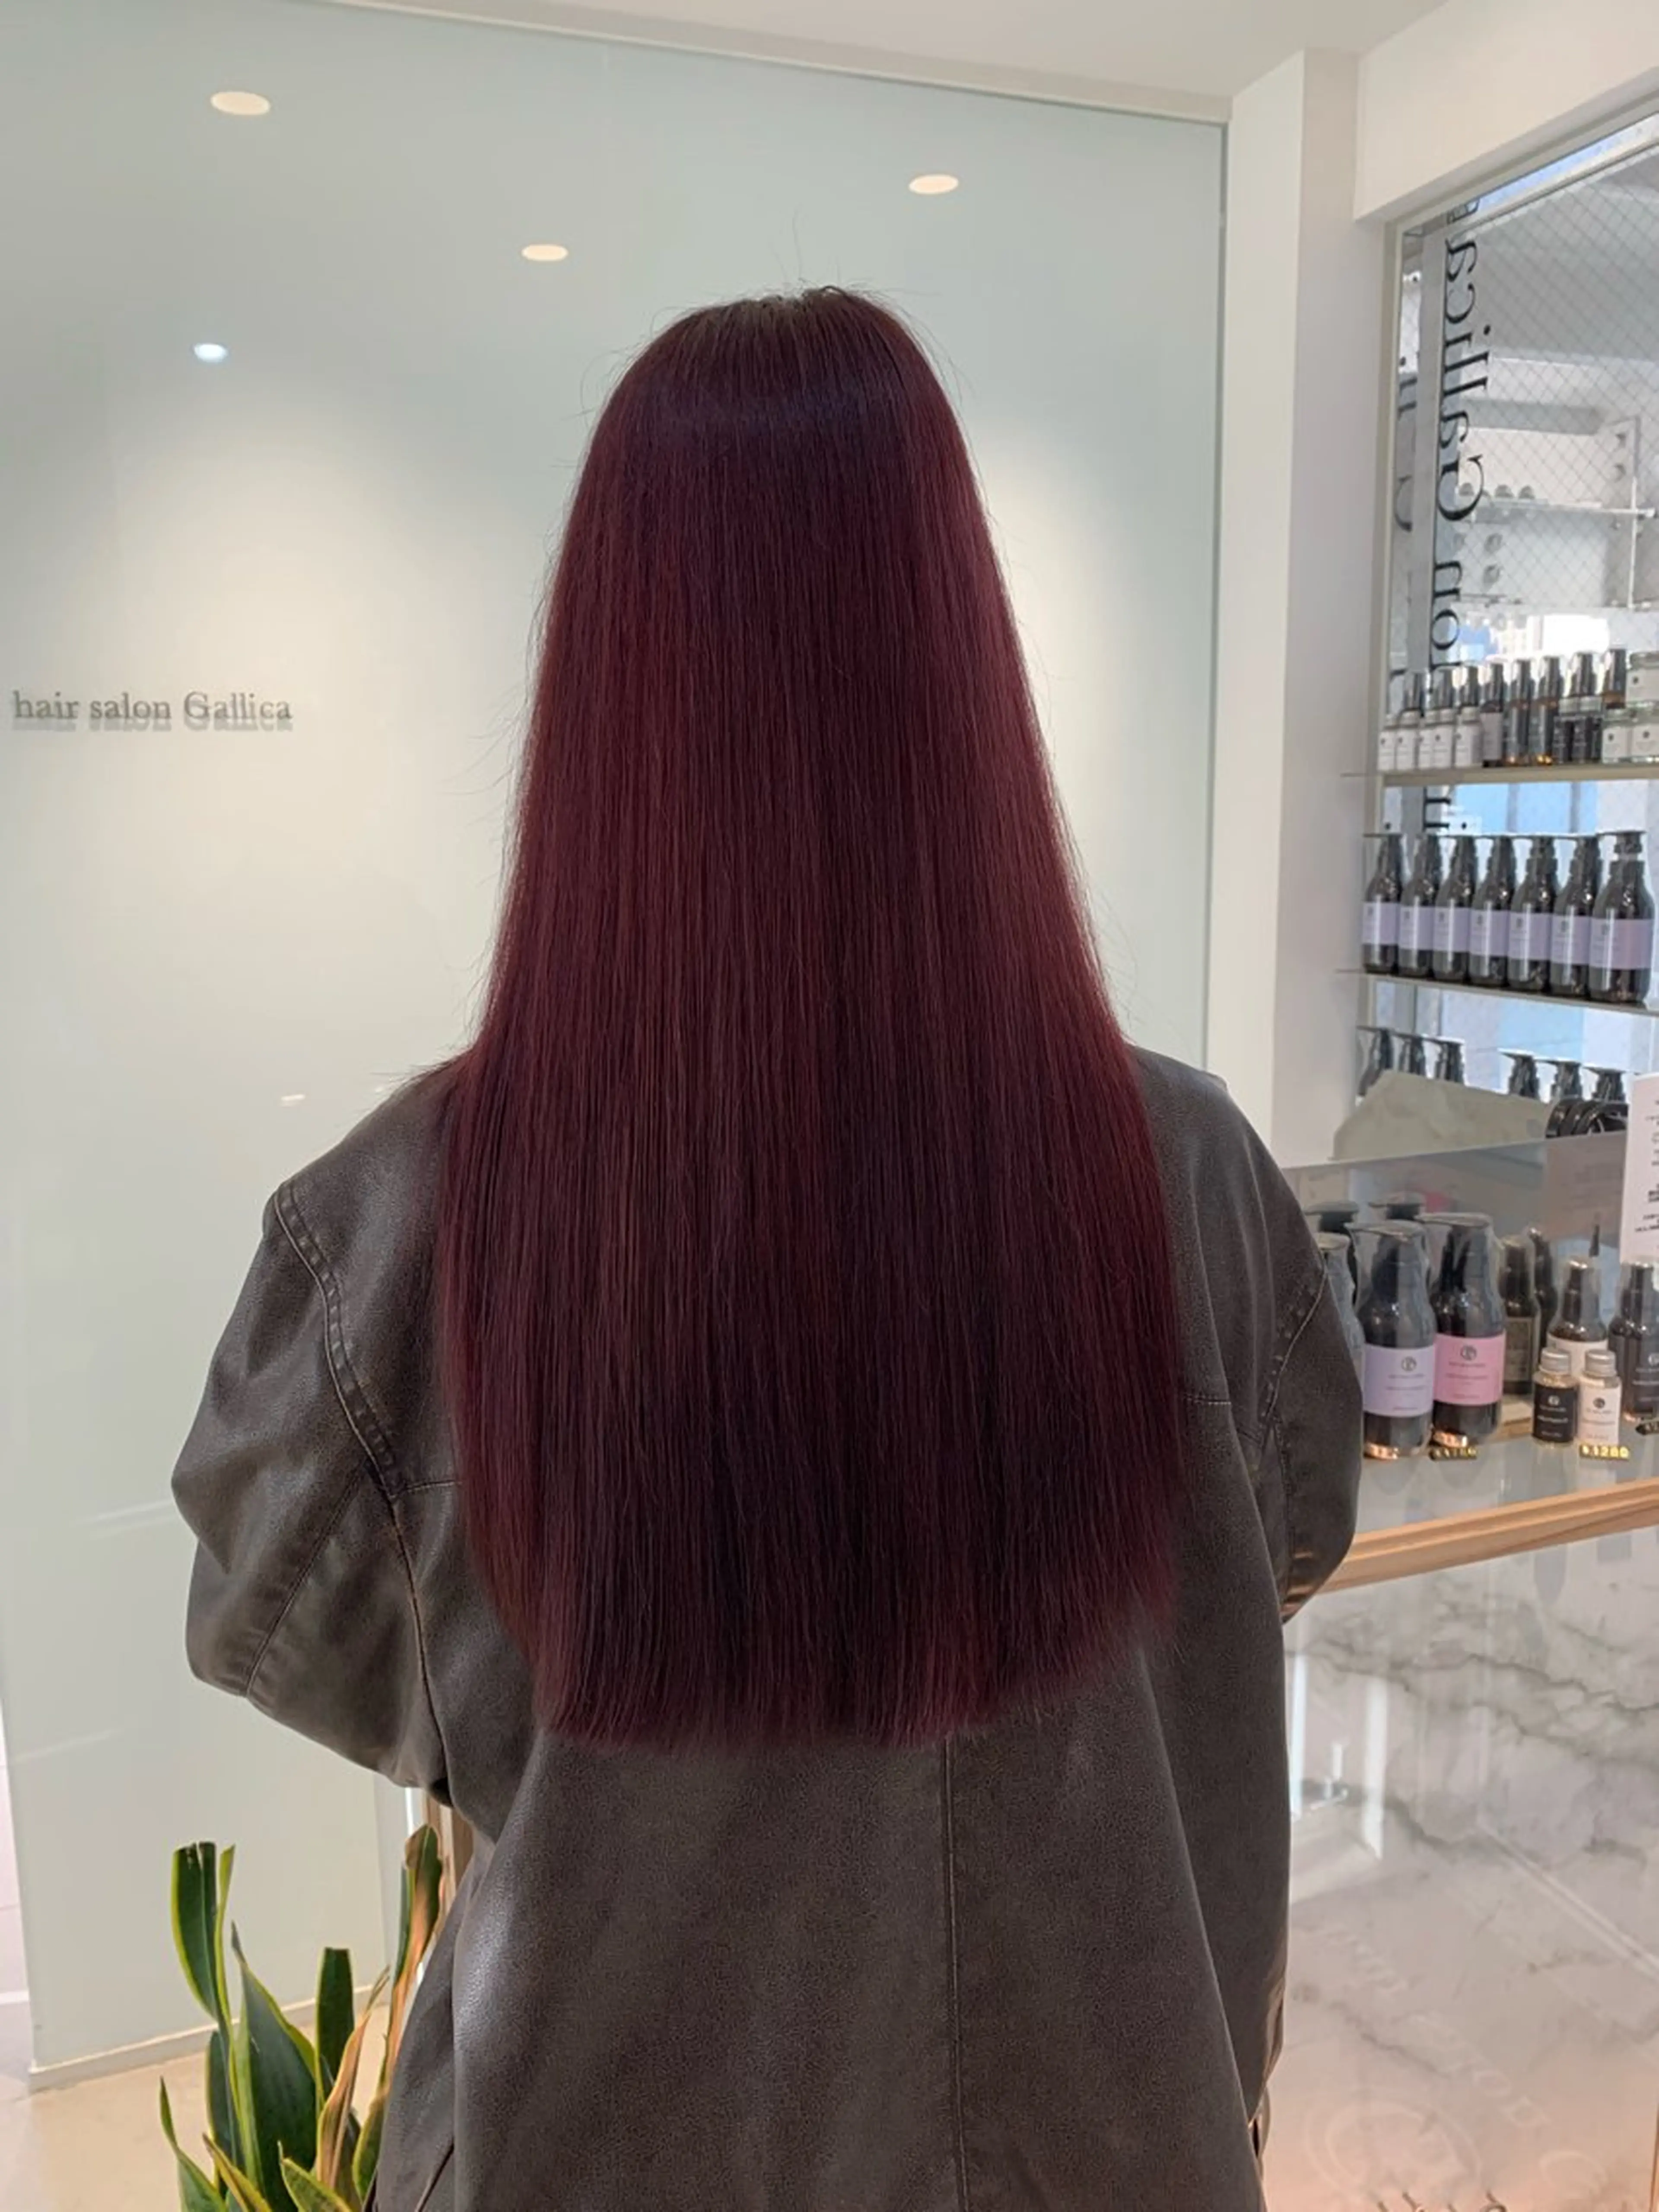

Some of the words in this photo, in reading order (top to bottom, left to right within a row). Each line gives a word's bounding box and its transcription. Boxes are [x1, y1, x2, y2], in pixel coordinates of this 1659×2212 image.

[13, 690, 79, 719] hair
[90, 692, 172, 720] salon
[184, 691, 294, 720] Gallica
